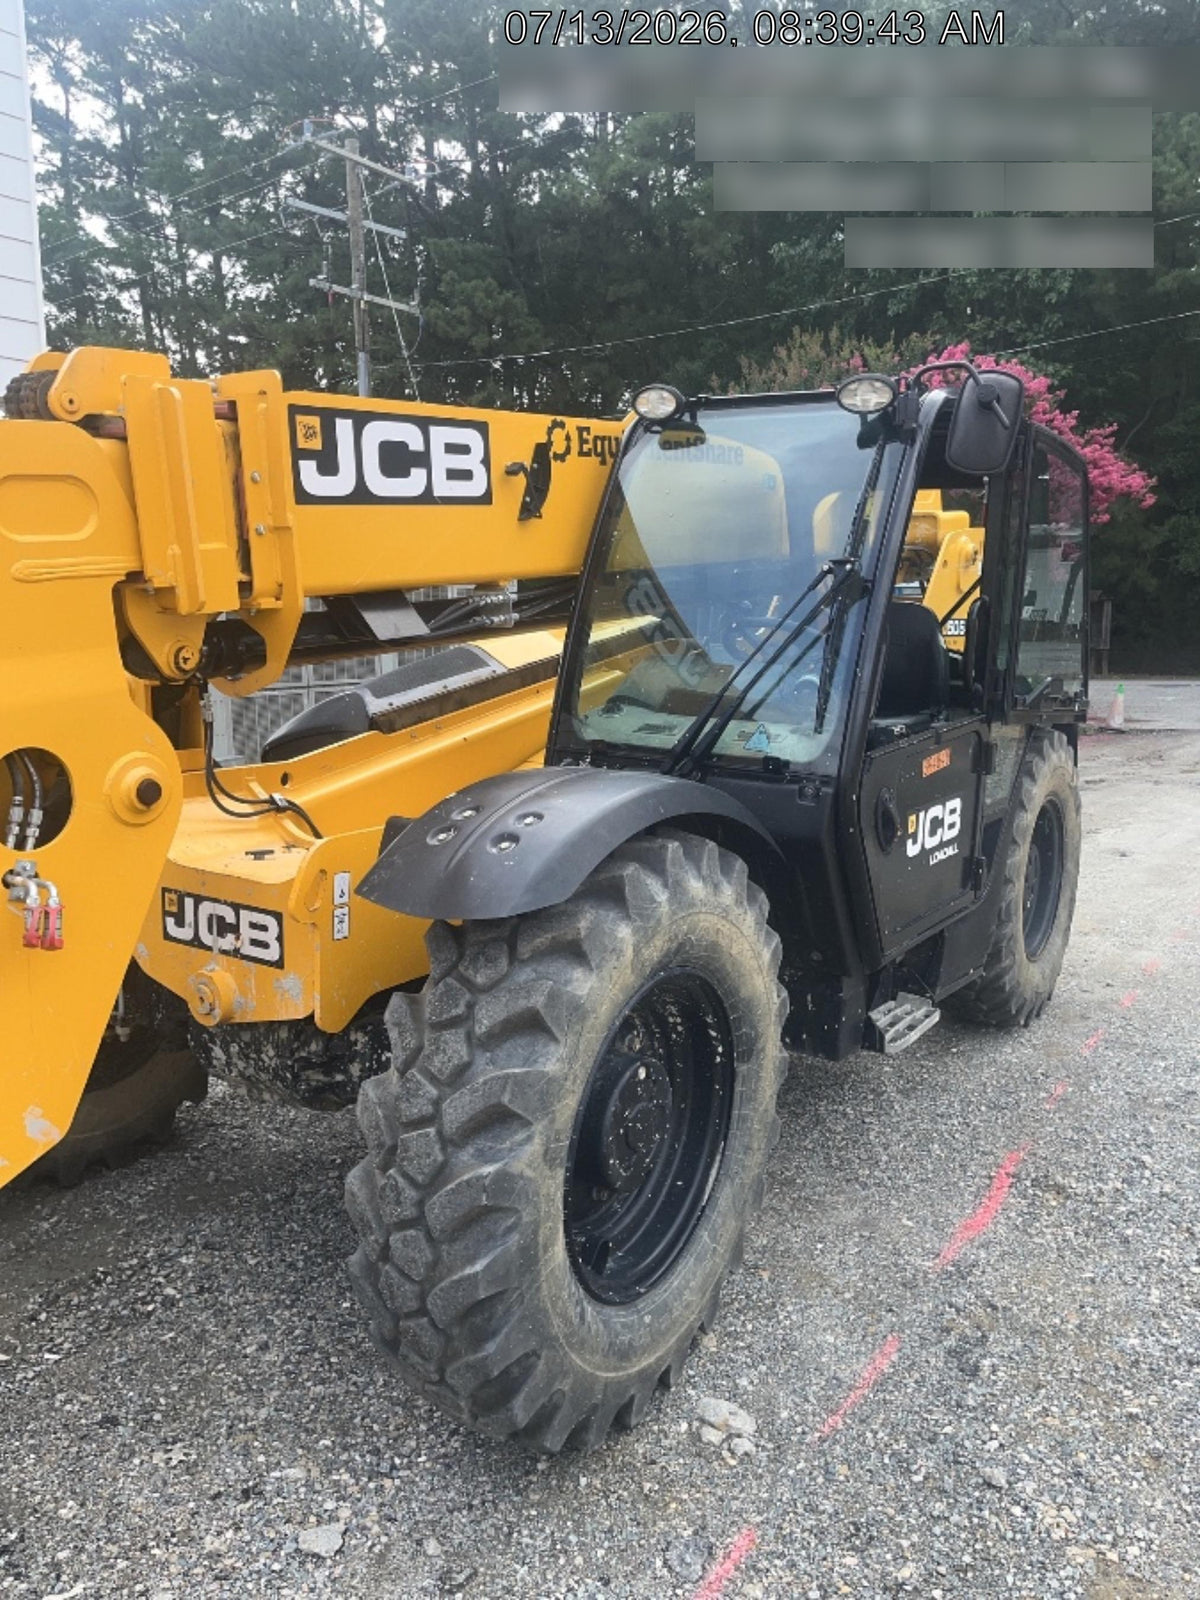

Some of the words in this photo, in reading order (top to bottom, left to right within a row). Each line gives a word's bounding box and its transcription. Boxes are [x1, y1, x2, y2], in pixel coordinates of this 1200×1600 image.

[299, 417, 488, 498] JCB
[906, 797, 962, 858] JCB
[165, 896, 281, 962] JCB
